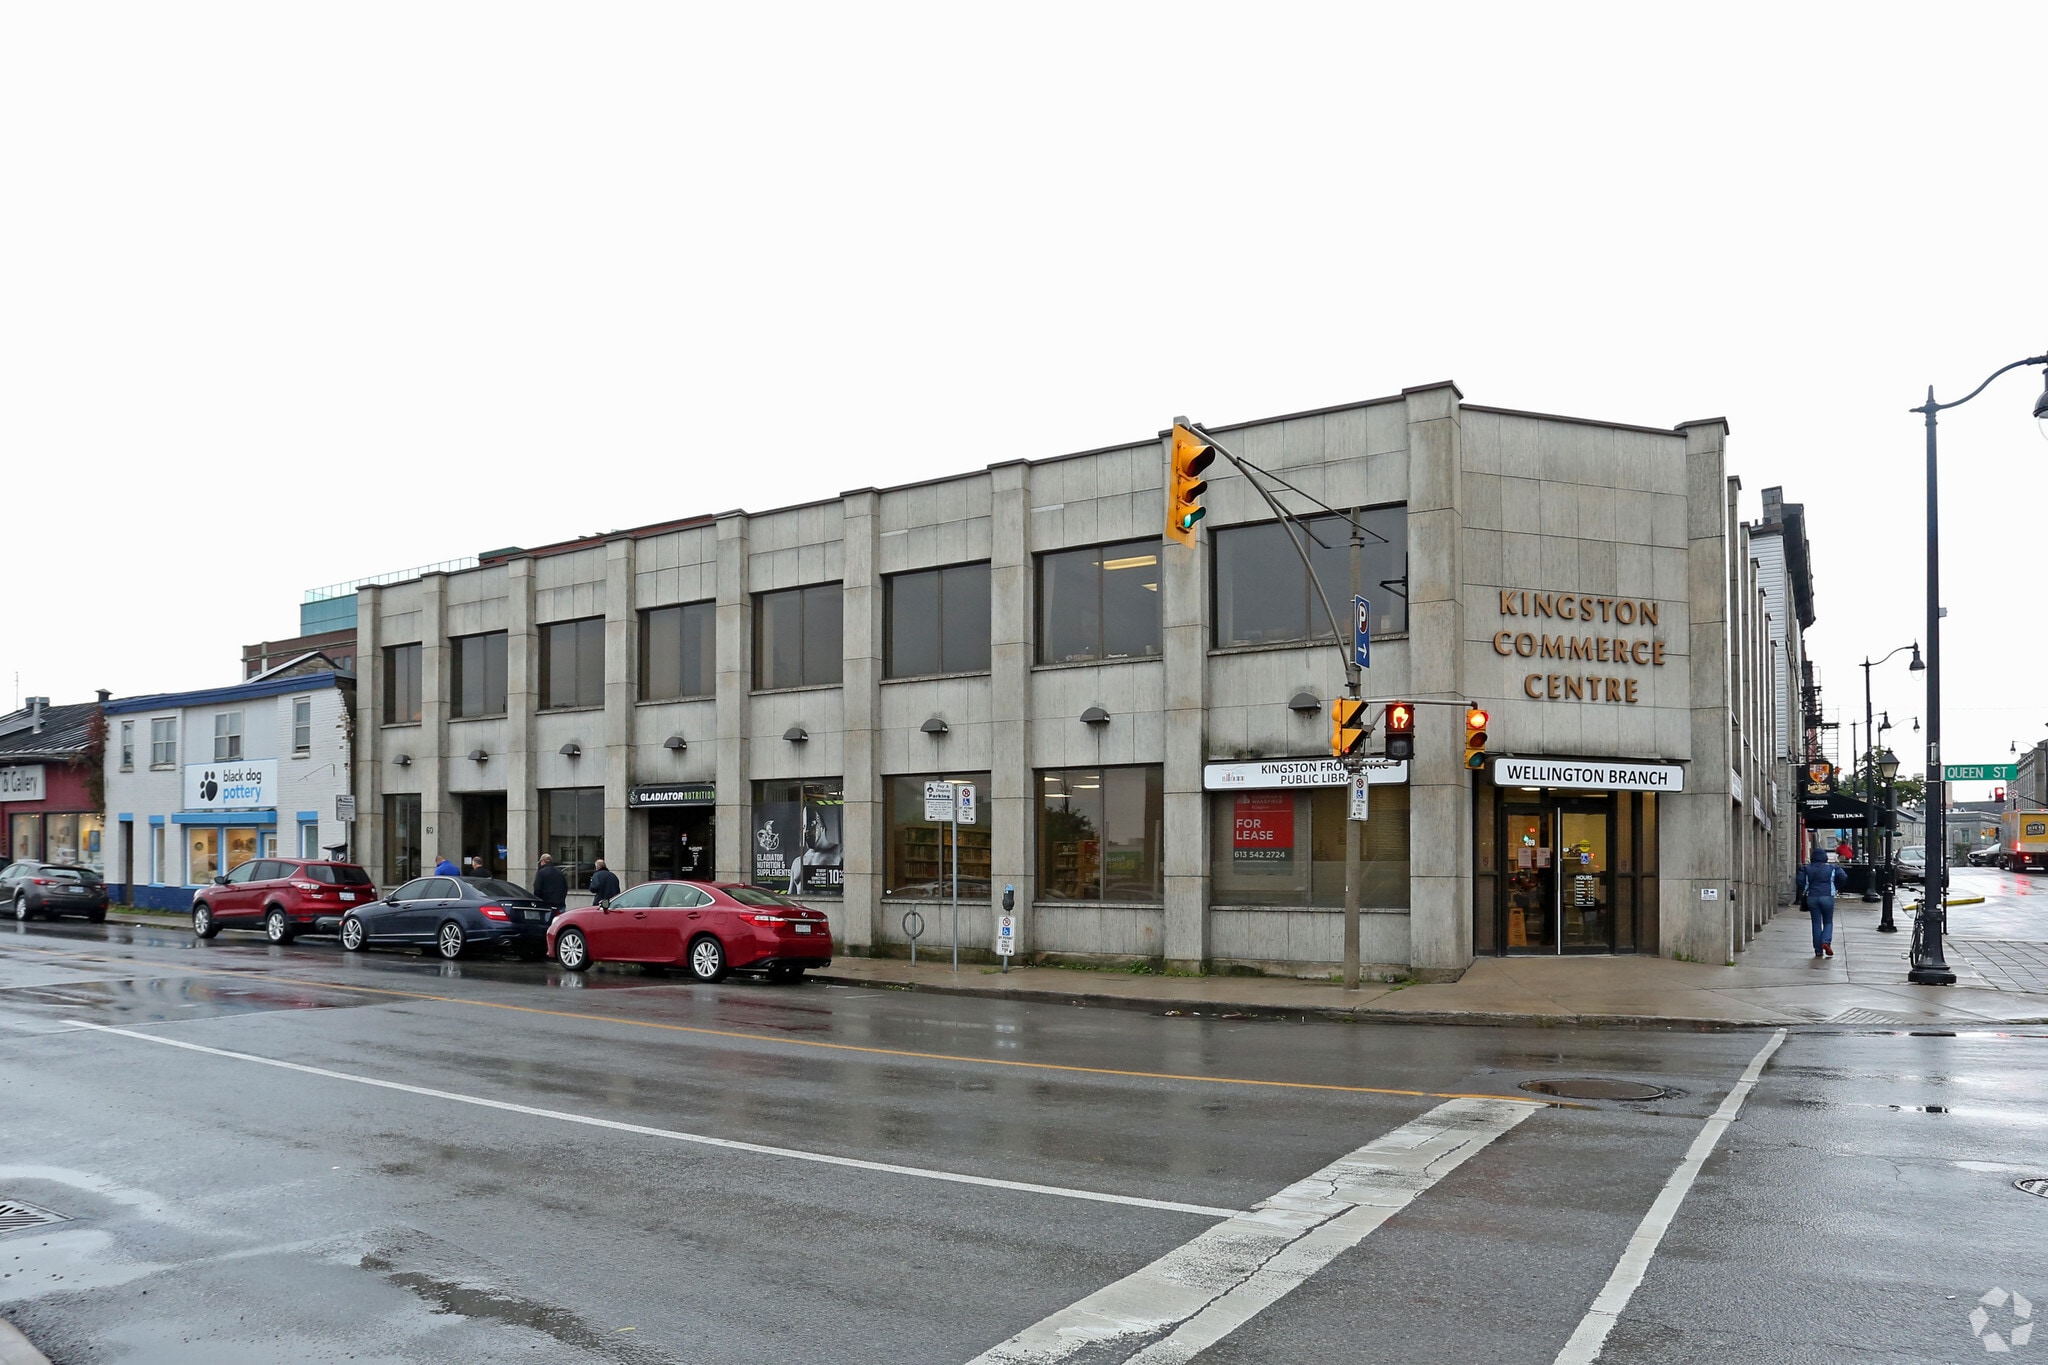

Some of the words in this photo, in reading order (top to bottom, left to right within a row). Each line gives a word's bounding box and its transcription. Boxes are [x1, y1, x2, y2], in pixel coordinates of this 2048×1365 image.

[1500, 590, 1659, 625] KINGSTON
[1493, 630, 1666, 665] COMMERCE
[1524, 673, 1638, 703] CENTRE
[1261, 763, 1317, 775] KINGSTON
[1506, 764, 1604, 783] WELLINGTON
[1608, 770, 1668, 785] BRANCH
[1947, 767, 1984, 778] QUEEN
[1992, 766, 2008, 778] ST
[223, 769, 244, 782] black
[245, 767, 262, 784] dog
[1280, 773, 1318, 785] PUBLIC
[223, 784, 262, 804] pottery
[640, 792, 684, 802] GLADIATOR
[684, 791, 715, 800] NUTRITION
[1236, 818, 1262, 829] FOR
[426, 826, 434, 834] 60
[1236, 830, 1274, 840] LEASE
[756, 853, 784, 861] GLADIATOR
[756, 861, 780, 869] NUTRITION
[781, 861, 786, 869] &
[756, 868, 791, 877] SUPPLEMENTS
